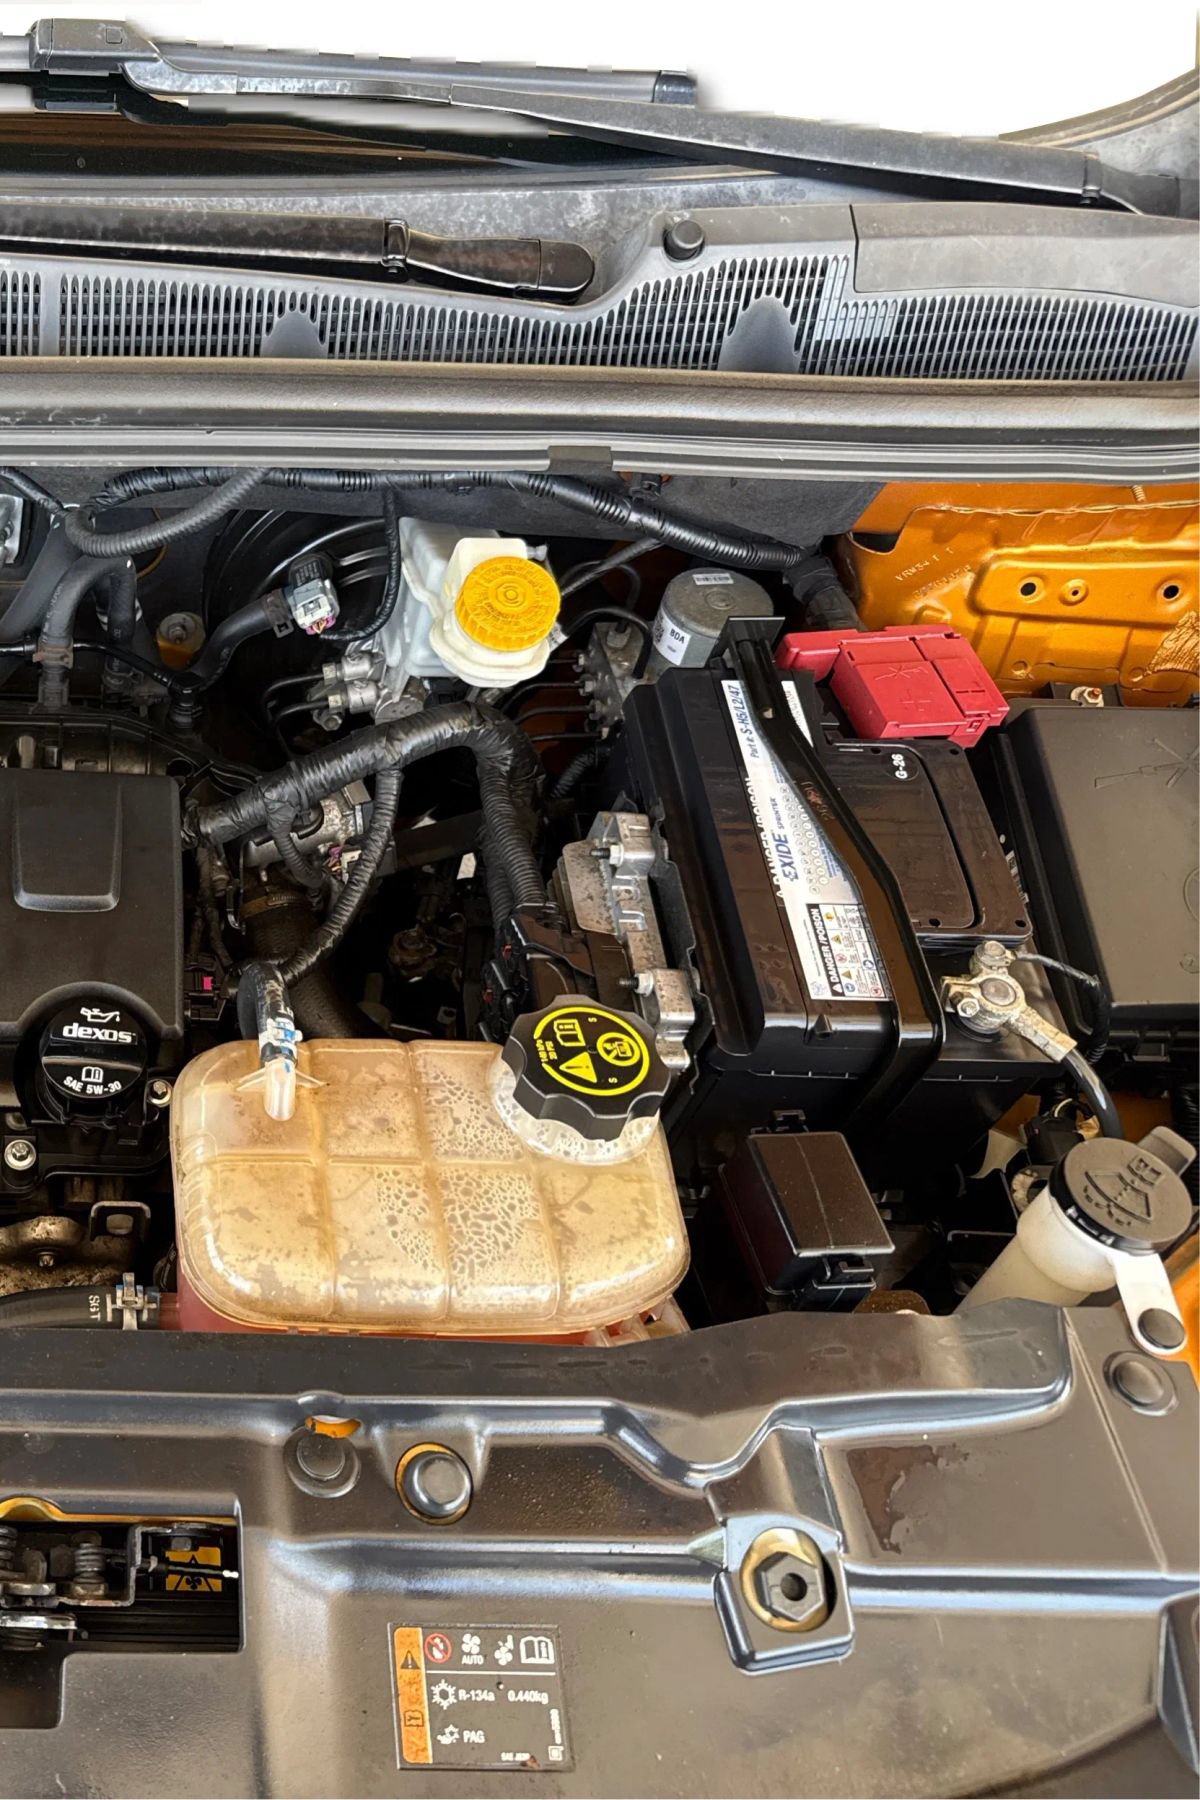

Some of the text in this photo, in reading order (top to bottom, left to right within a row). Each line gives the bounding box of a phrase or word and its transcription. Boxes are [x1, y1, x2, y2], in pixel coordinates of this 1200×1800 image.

[891, 753, 908, 779] G-26
[770, 797, 785, 830] SPRINTER
[771, 831, 799, 882] EXIDE
[821, 945, 840, 983] DANGER
[62, 1022, 133, 1043] dexos
[63, 1076, 122, 1095] SAE 5W-30
[461, 1654, 484, 1665] AUTO
[458, 1688, 549, 1705] R-134a 0.440kg
[463, 1730, 486, 1743] PAG
